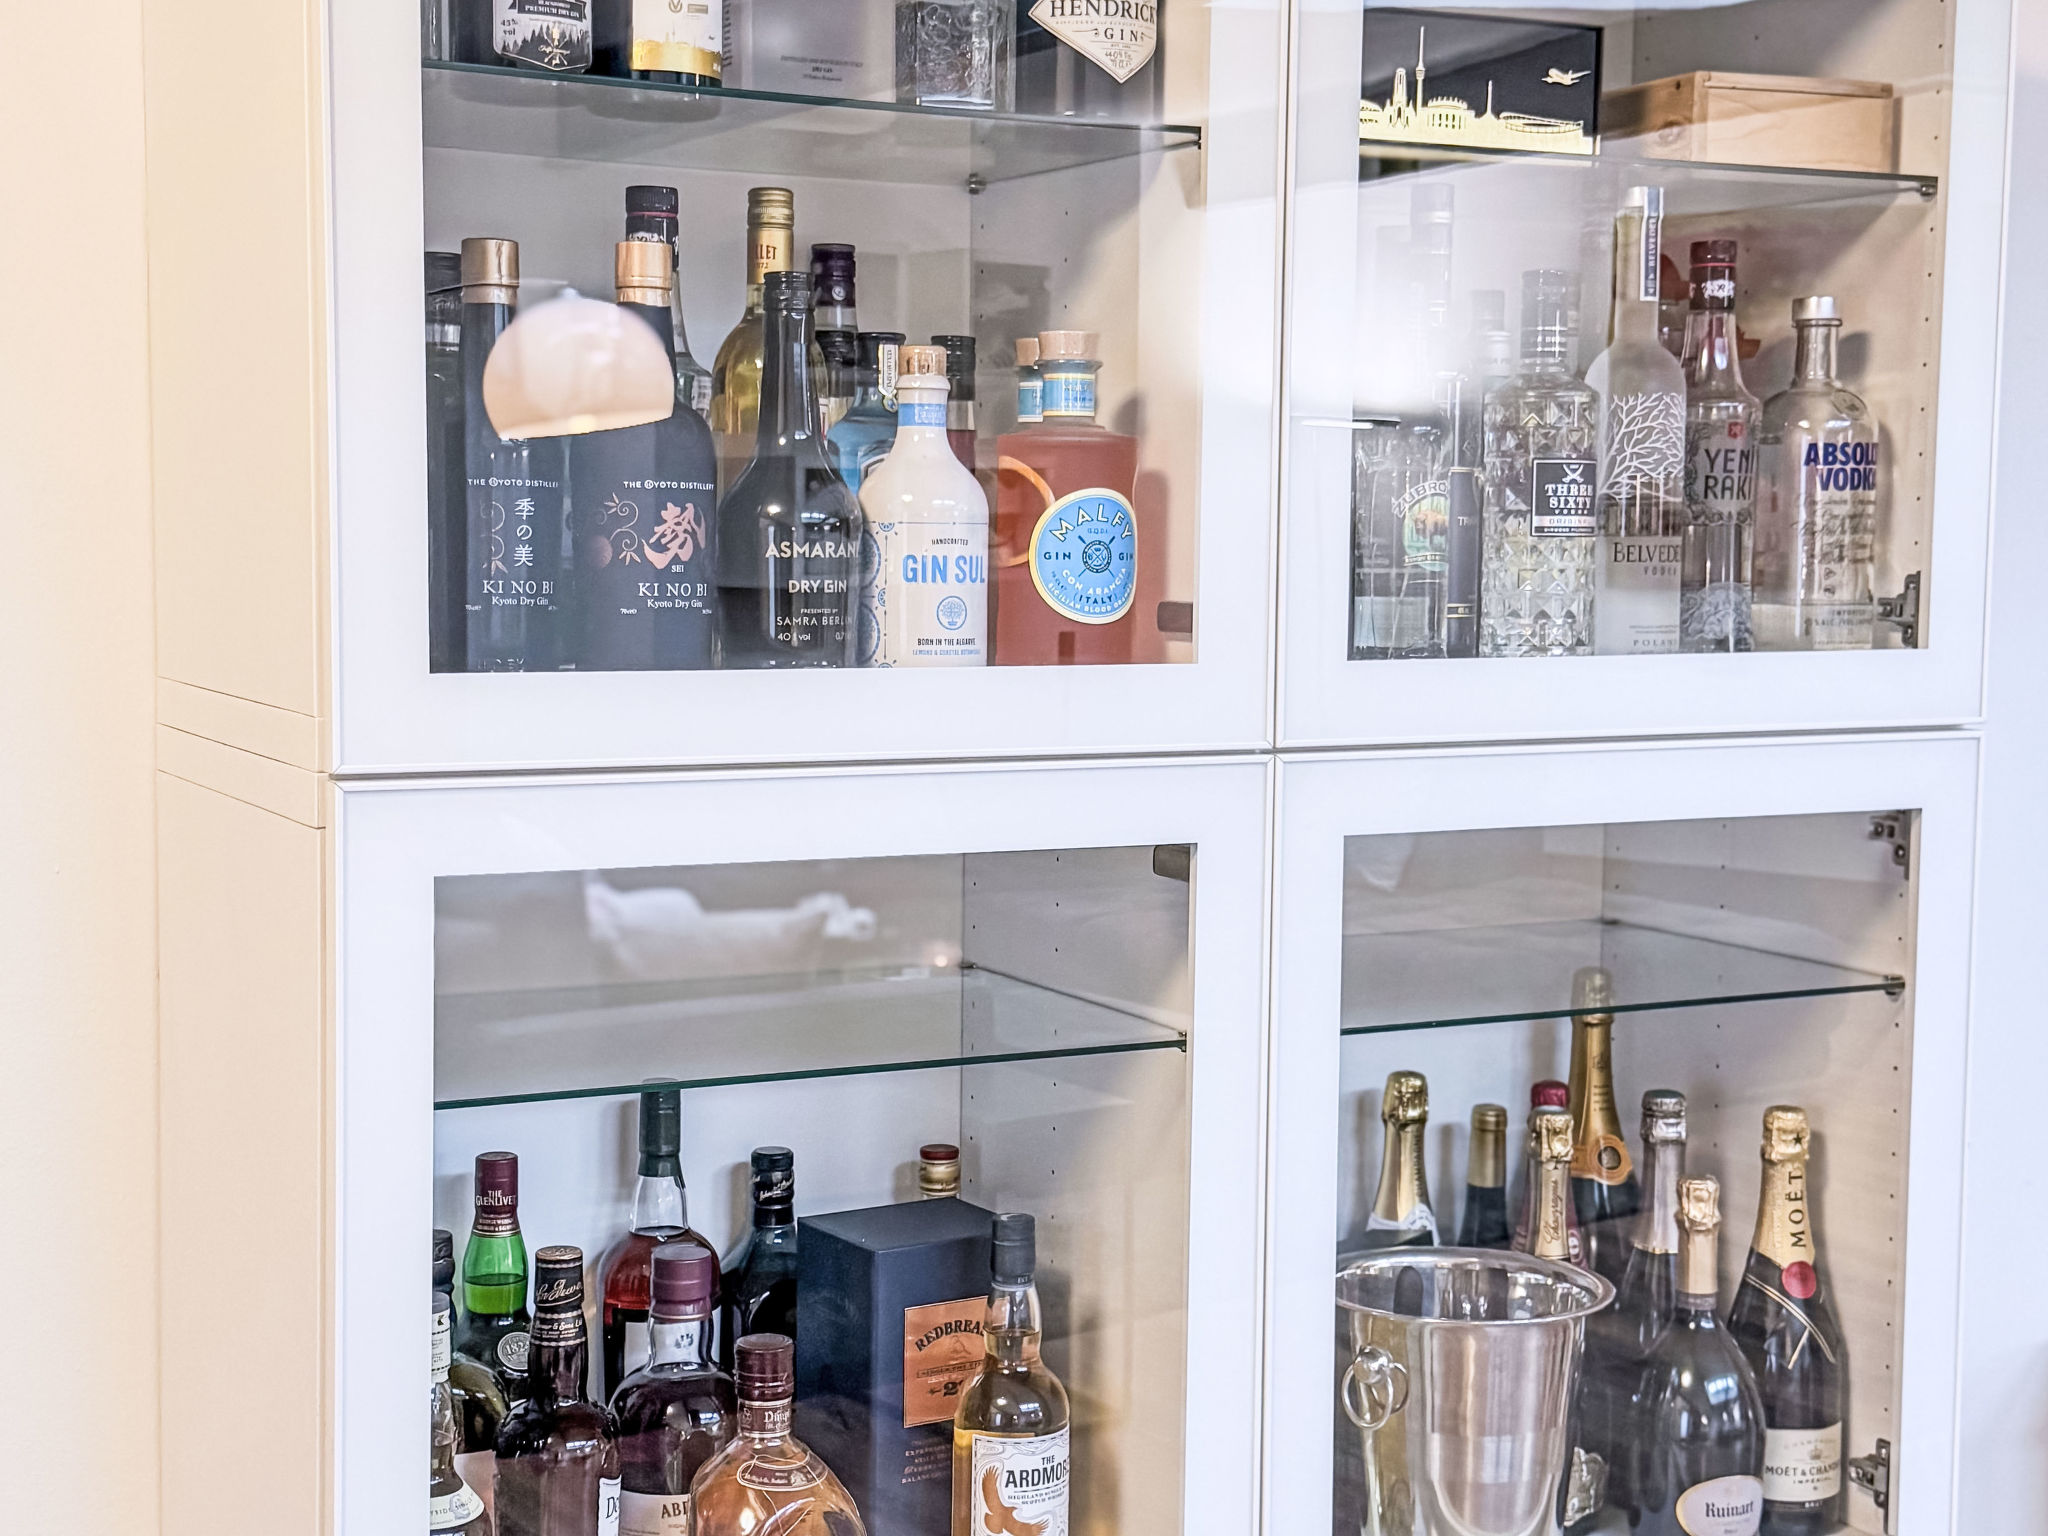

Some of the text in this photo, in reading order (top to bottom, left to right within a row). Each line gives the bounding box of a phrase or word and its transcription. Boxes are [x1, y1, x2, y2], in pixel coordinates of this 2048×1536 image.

[525, 5, 557, 14] PREMIUM
[558, 8, 570, 16] DRY
[1104, 27, 1138, 42] GIN
[623, 481, 641, 489] THE
[1544, 484, 1593, 496] THREE
[1549, 497, 1591, 509] SIXTY
[1049, 503, 1133, 543] MALFY
[513, 497, 535, 567] 季の美
[1044, 551, 1072, 561] GIN
[671, 564, 684, 573] SEI
[902, 554, 985, 584] GIN SUL
[1062, 569, 1083, 591] CON
[482, 580, 554, 595] KI NO BI
[638, 582, 708, 597] KI NO BI
[788, 579, 847, 594] DRY GIN
[491, 596, 549, 607] Kyoto Dry Gin
[647, 599, 703, 610] Kyoto Dry Gin
[1079, 594, 1112, 605] ITALY
[776, 616, 818, 626] SAMRA
[798, 633, 811, 641] vol
[917, 637, 934, 646] BORN
[935, 637, 943, 646] IN
[943, 637, 954, 646] THE
[487, 1190, 502, 1198] THE
[475, 1195, 517, 1206] GLENLIVET
[1785, 1171, 1806, 1248] MOËT
[1041, 1454, 1056, 1466] THE
[1800, 1469, 1807, 1477] &
[1705, 1500, 1754, 1518] Ruinart
